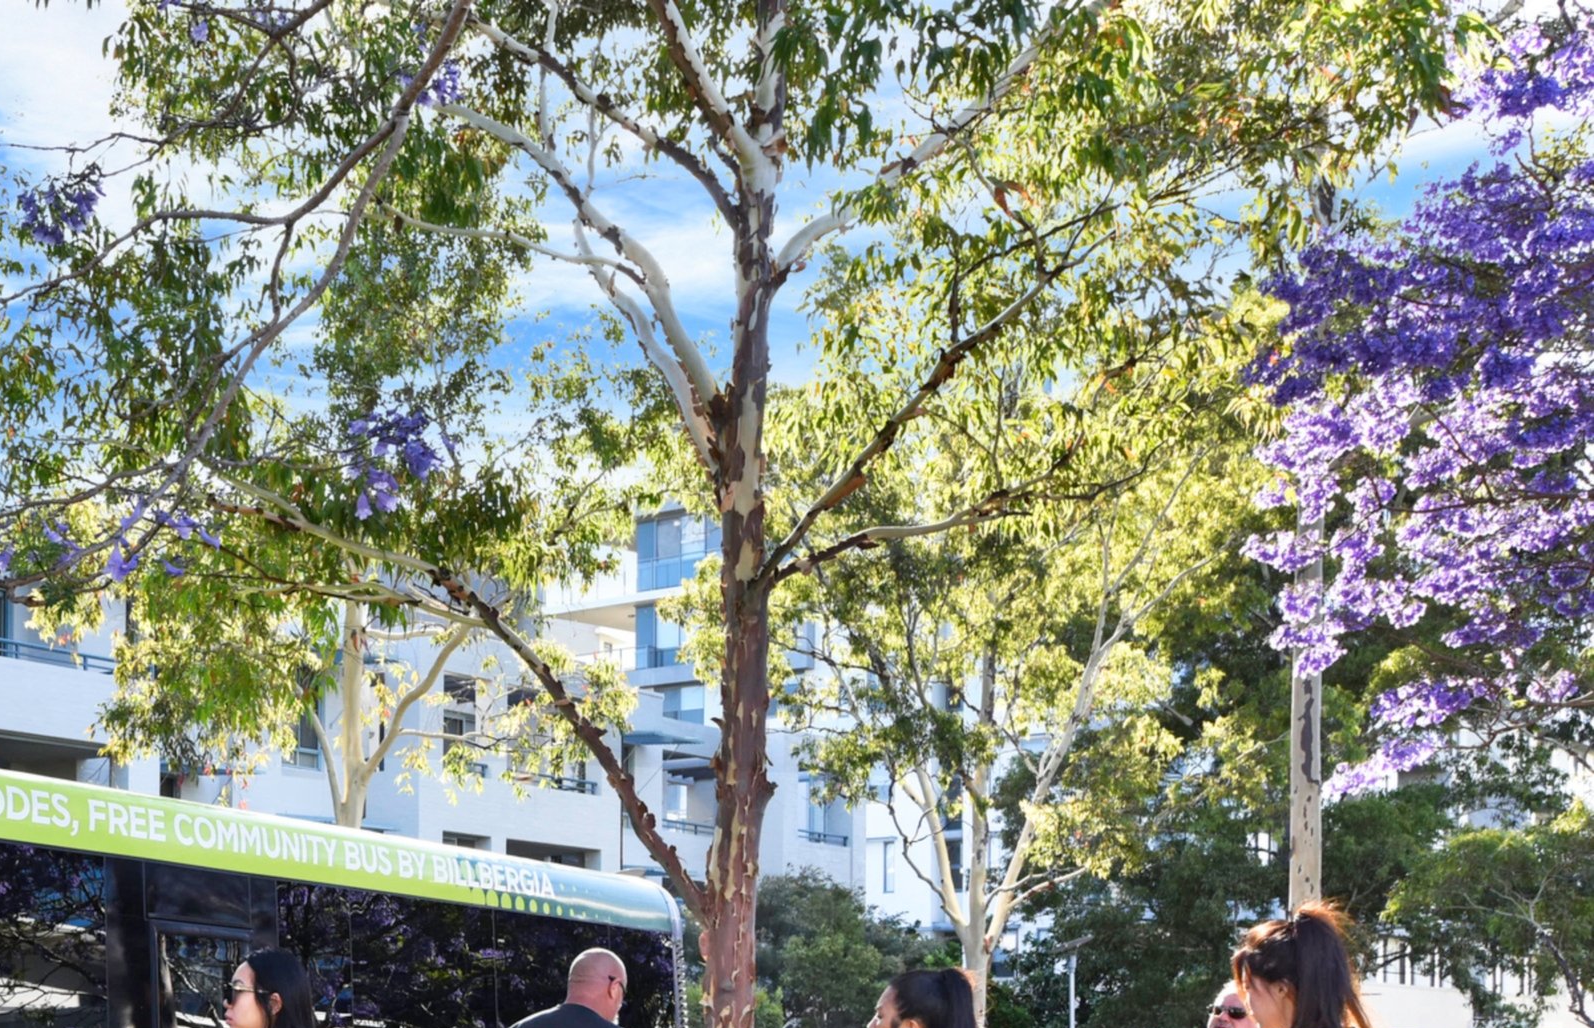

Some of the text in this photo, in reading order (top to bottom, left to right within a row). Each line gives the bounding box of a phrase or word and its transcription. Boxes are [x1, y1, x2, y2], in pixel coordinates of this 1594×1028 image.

[87, 798, 166, 842] FREE
[173, 813, 338, 868] COMMUNITY
[342, 840, 393, 877] BUS
[397, 851, 428, 880] BY
[430, 855, 557, 898] BILLBERGIA
